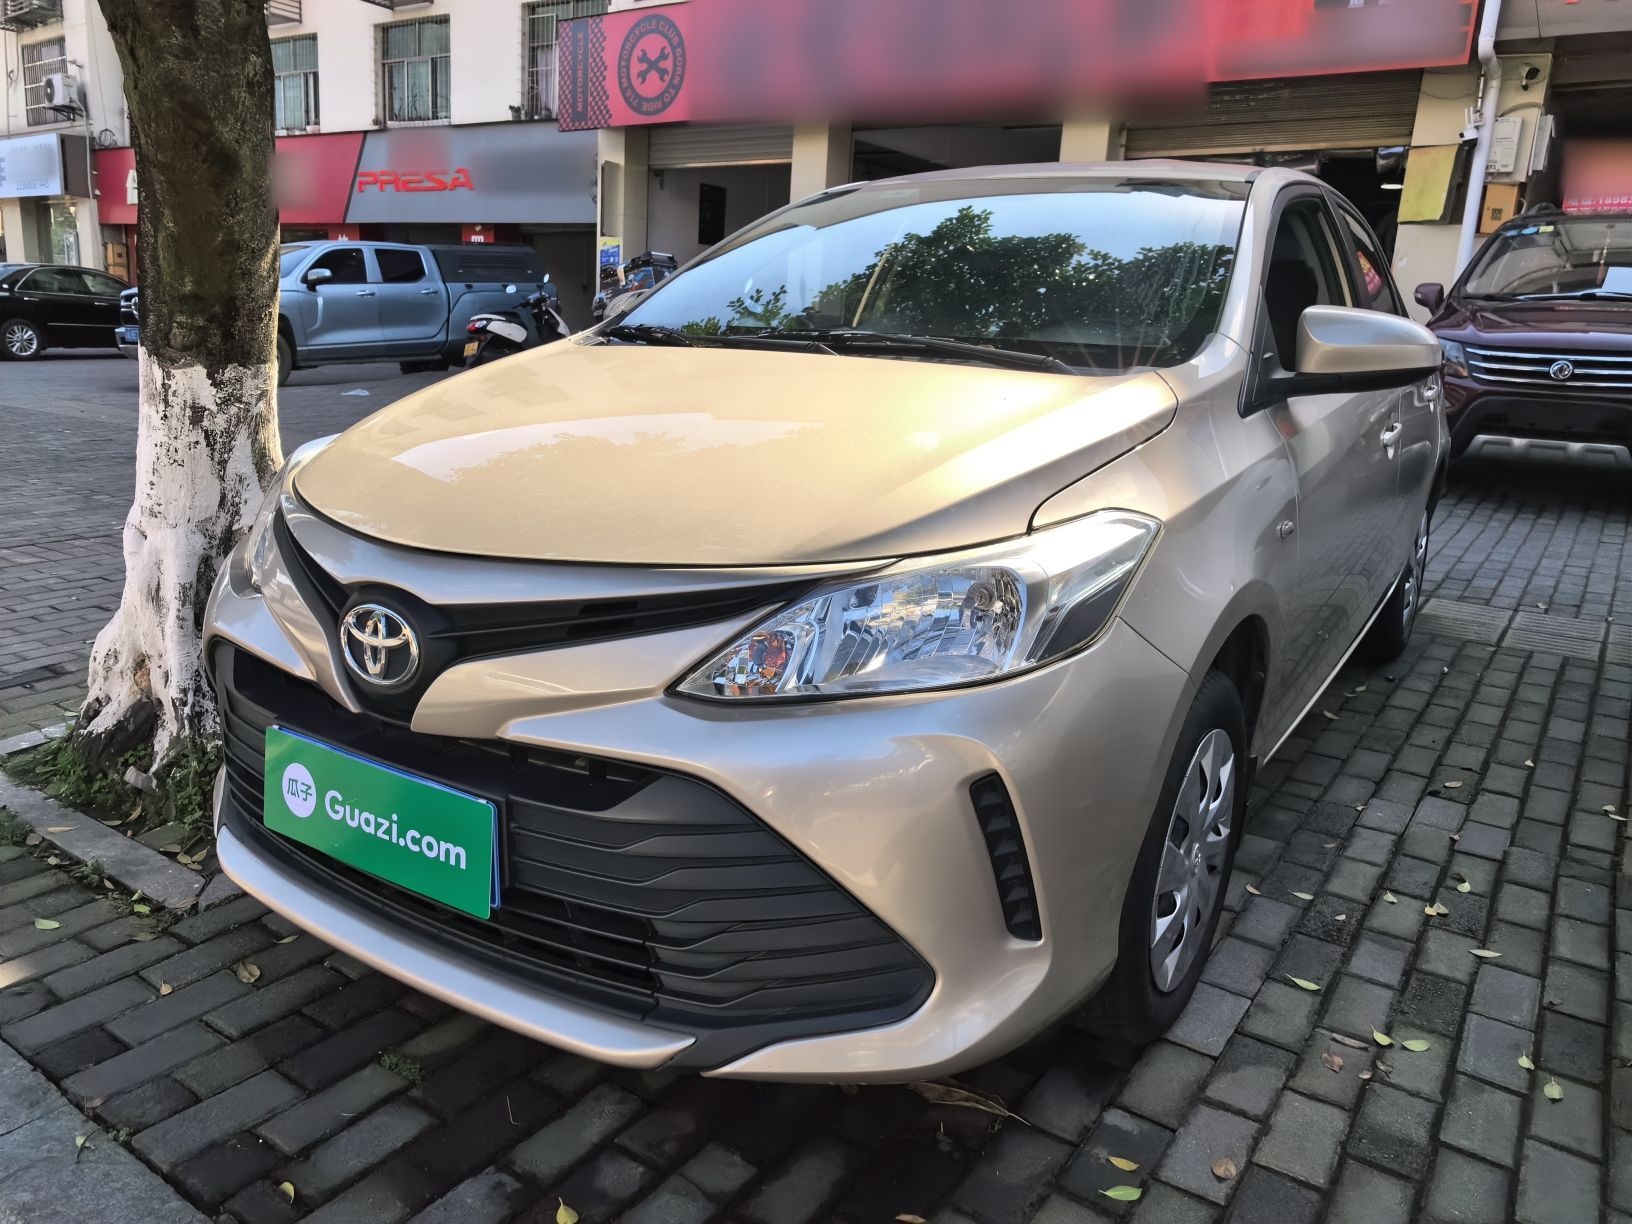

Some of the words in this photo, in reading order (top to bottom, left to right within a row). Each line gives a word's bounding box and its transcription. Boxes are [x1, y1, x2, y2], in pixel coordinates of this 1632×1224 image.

[659, 21, 680, 46] CLUB
[576, 31, 584, 112] MOTORCYCLE
[673, 47, 683, 86] BORN
[663, 87, 675, 101] TO
[641, 101, 663, 113] RIDE
[357, 167, 475, 193] PRESA
[286, 777, 313, 802] 瓜子
[324, 789, 467, 871] Guazi.com
